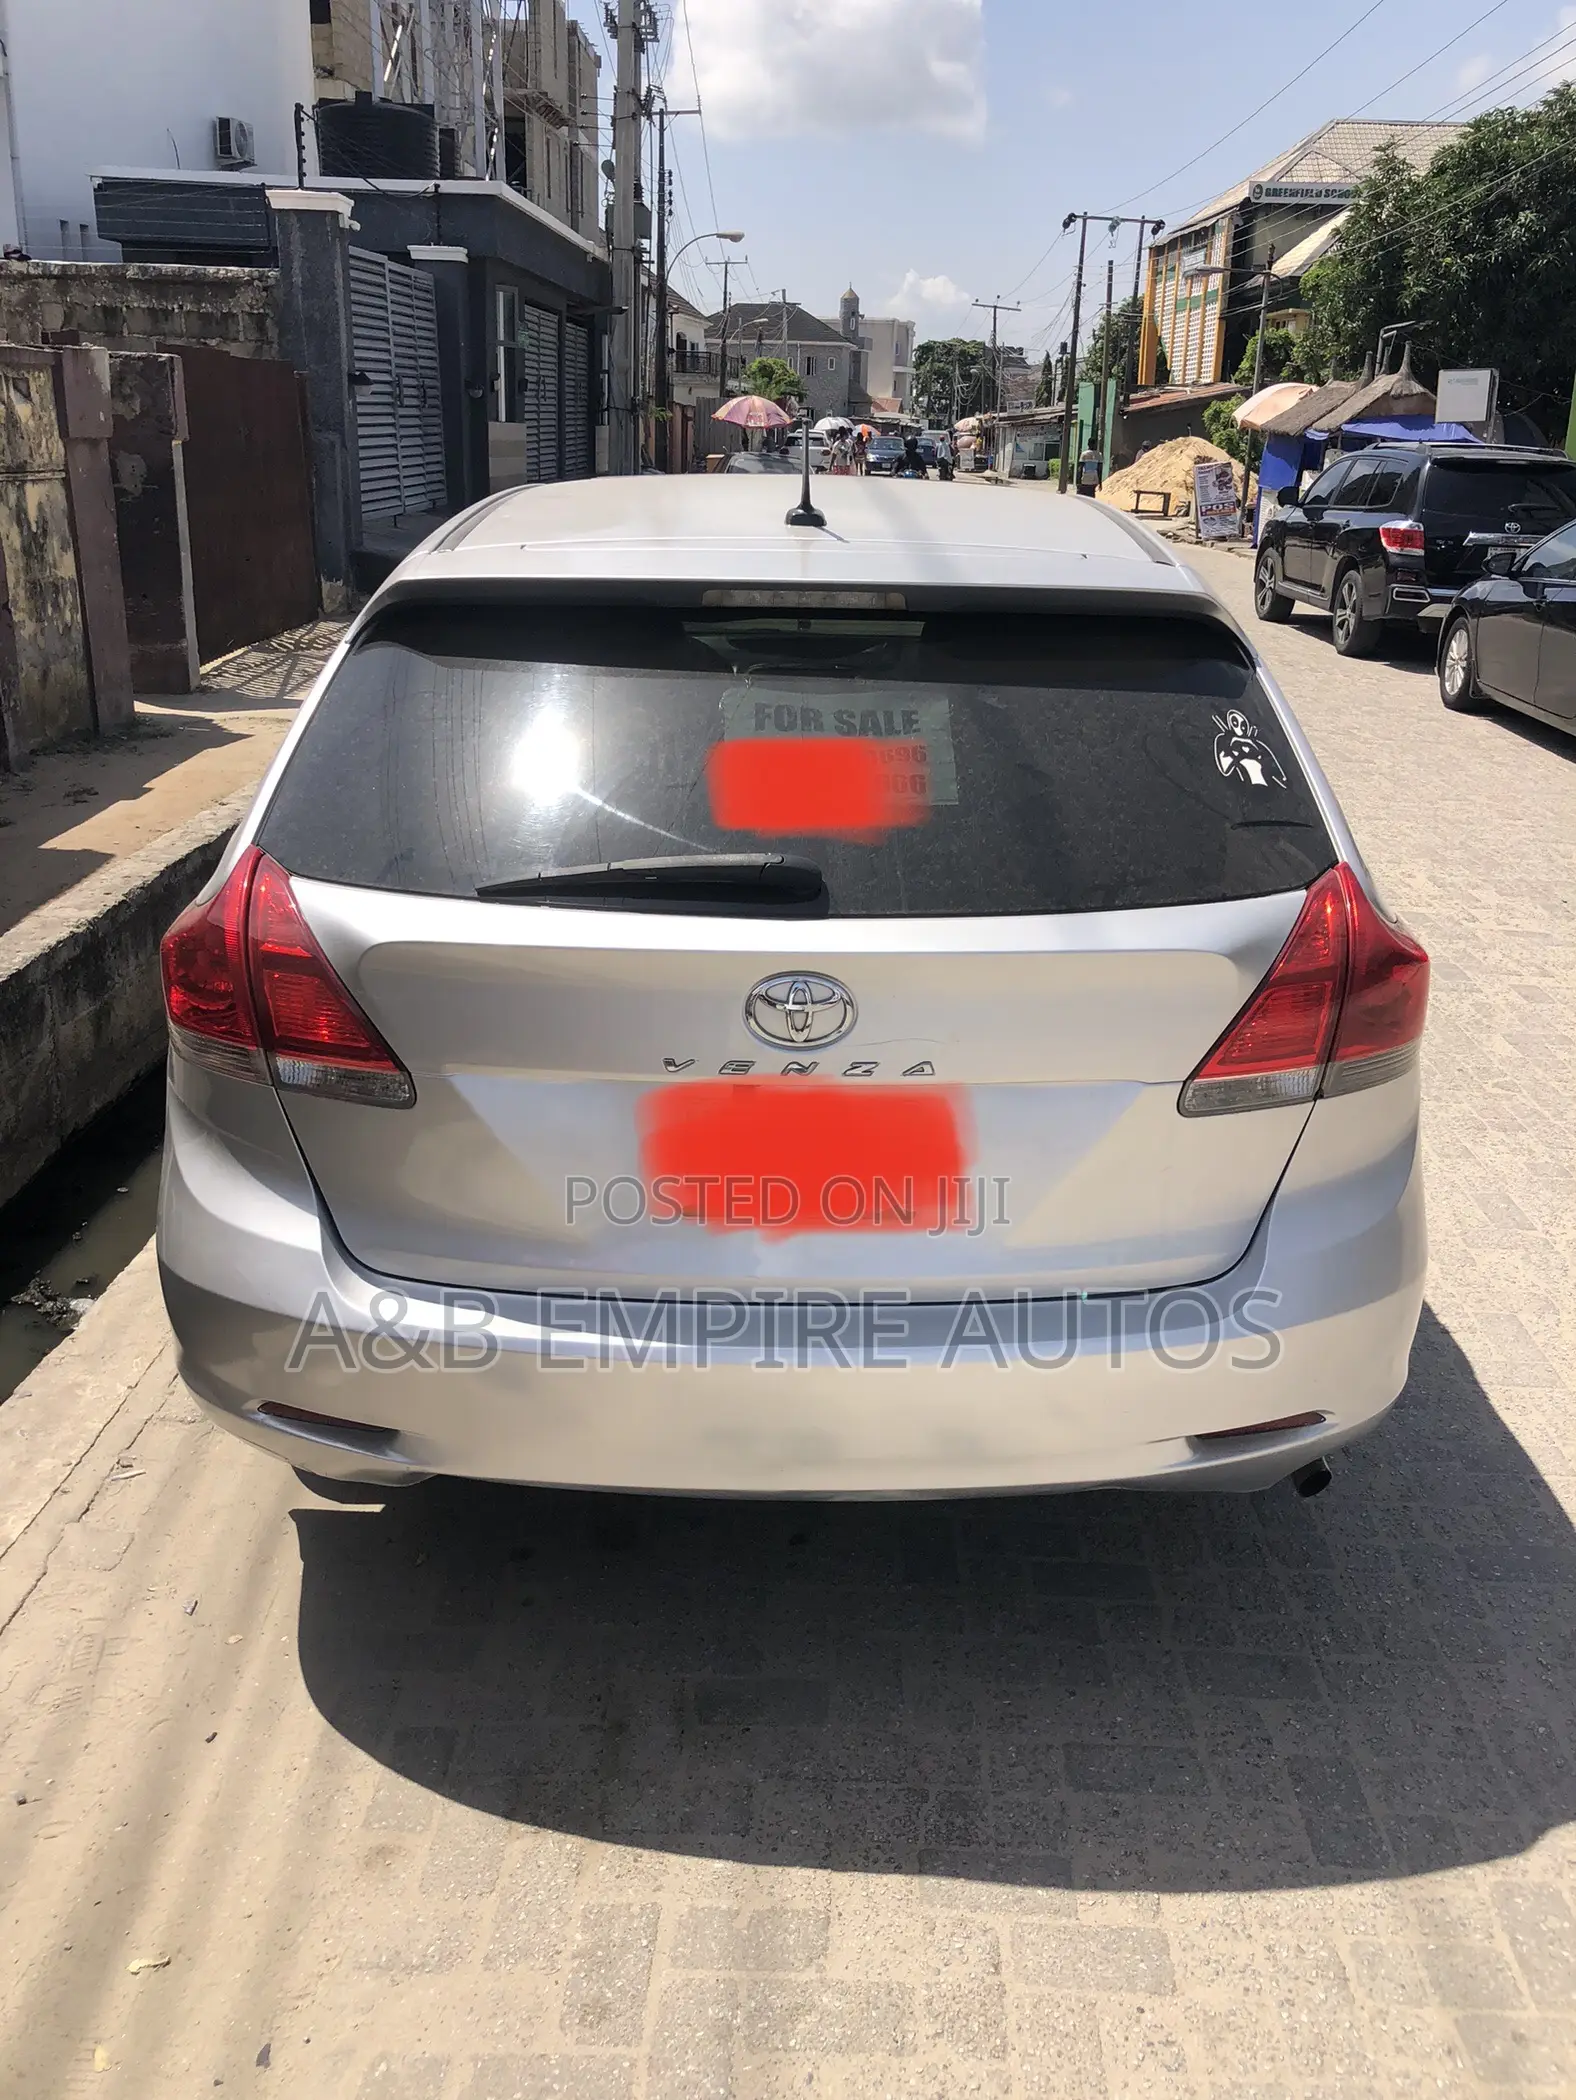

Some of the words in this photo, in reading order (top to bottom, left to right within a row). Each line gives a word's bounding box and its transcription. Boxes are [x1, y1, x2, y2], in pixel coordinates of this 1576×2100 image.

[1264, 187, 1322, 198] GREENFIELD
[1323, 188, 1357, 199] SCHO
[754, 703, 824, 732] FOR
[833, 709, 921, 737] SALE
[662, 1057, 935, 1077] VENZA
